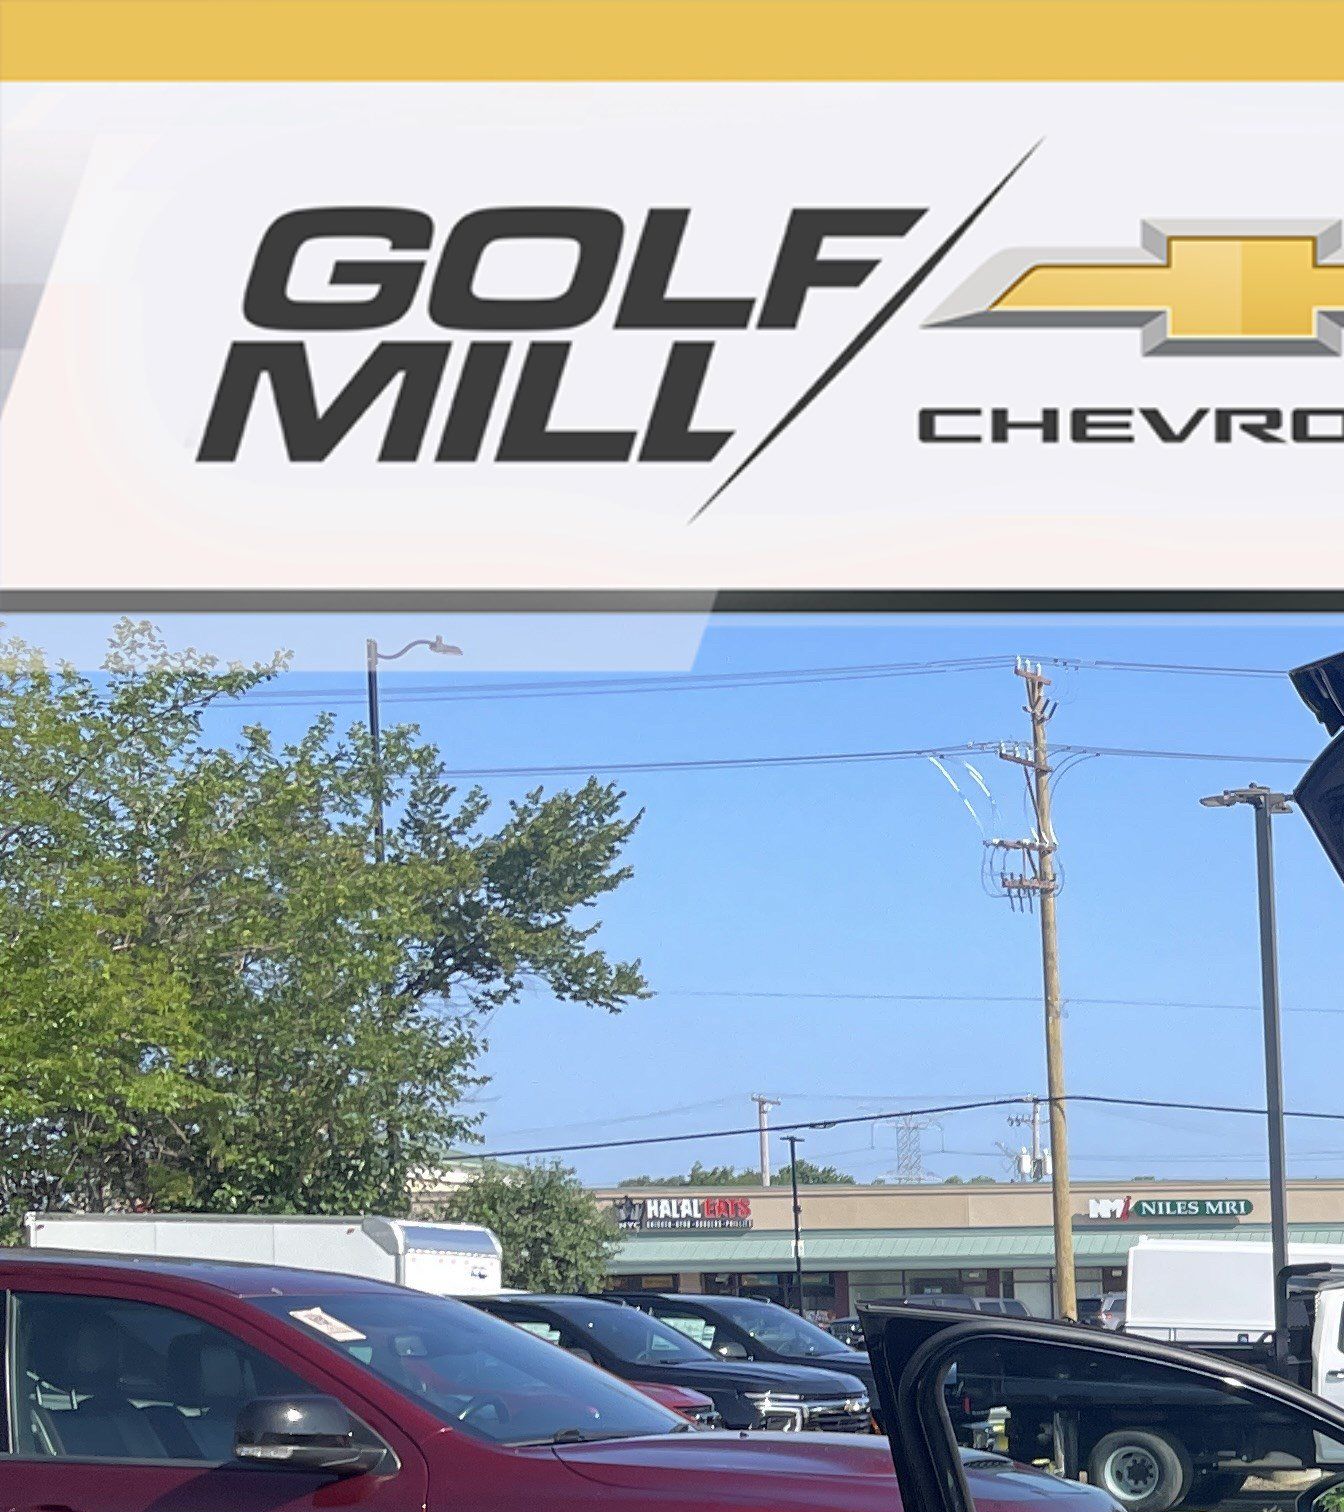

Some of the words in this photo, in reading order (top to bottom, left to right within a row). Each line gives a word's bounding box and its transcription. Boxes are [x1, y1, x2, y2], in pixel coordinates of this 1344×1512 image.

[647, 1198, 701, 1219] HALAL
[704, 1196, 752, 1220] EATS
[1141, 1201, 1199, 1215] NILES
[1205, 1201, 1246, 1215] MRI
